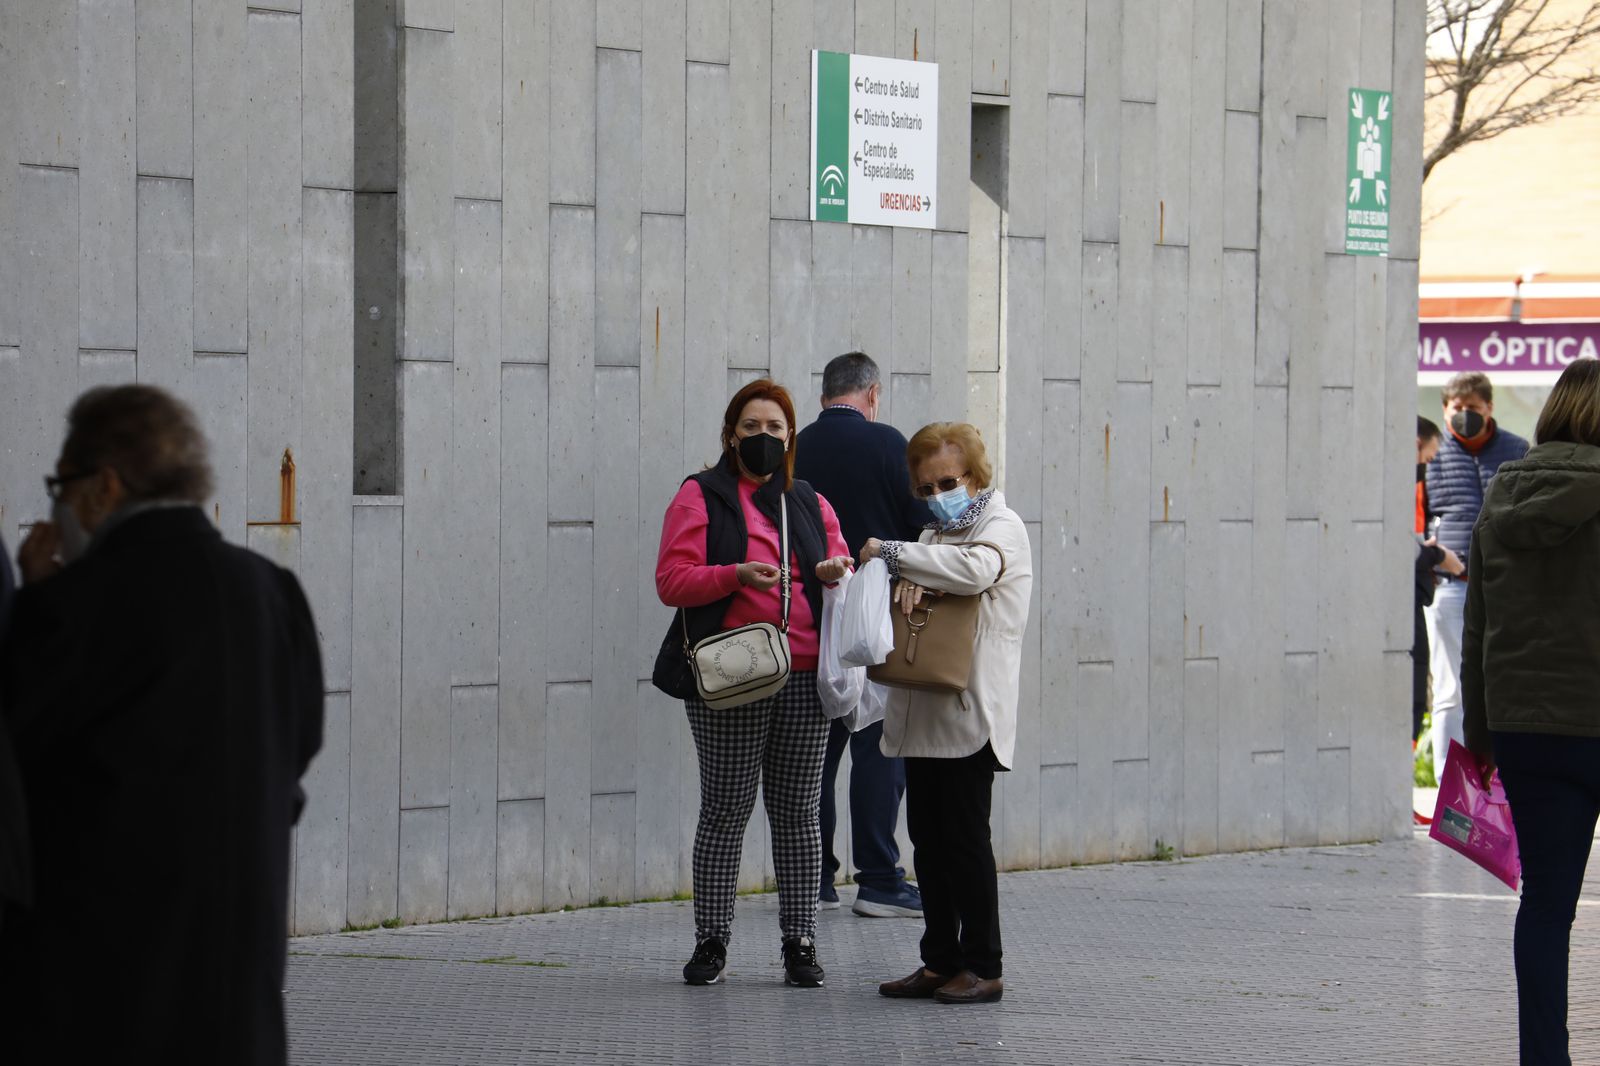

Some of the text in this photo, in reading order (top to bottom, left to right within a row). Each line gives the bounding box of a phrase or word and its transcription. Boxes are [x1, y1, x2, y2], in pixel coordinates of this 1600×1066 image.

[864, 76, 919, 99] Centro de Salud
[864, 108, 922, 131] Distrito Sanitario
[863, 139, 897, 159] Centro de
[863, 160, 914, 182] Especialidades
[880, 192, 921, 212] URGENCIAS
[1479, 331, 1598, 367] ÓPTICA
